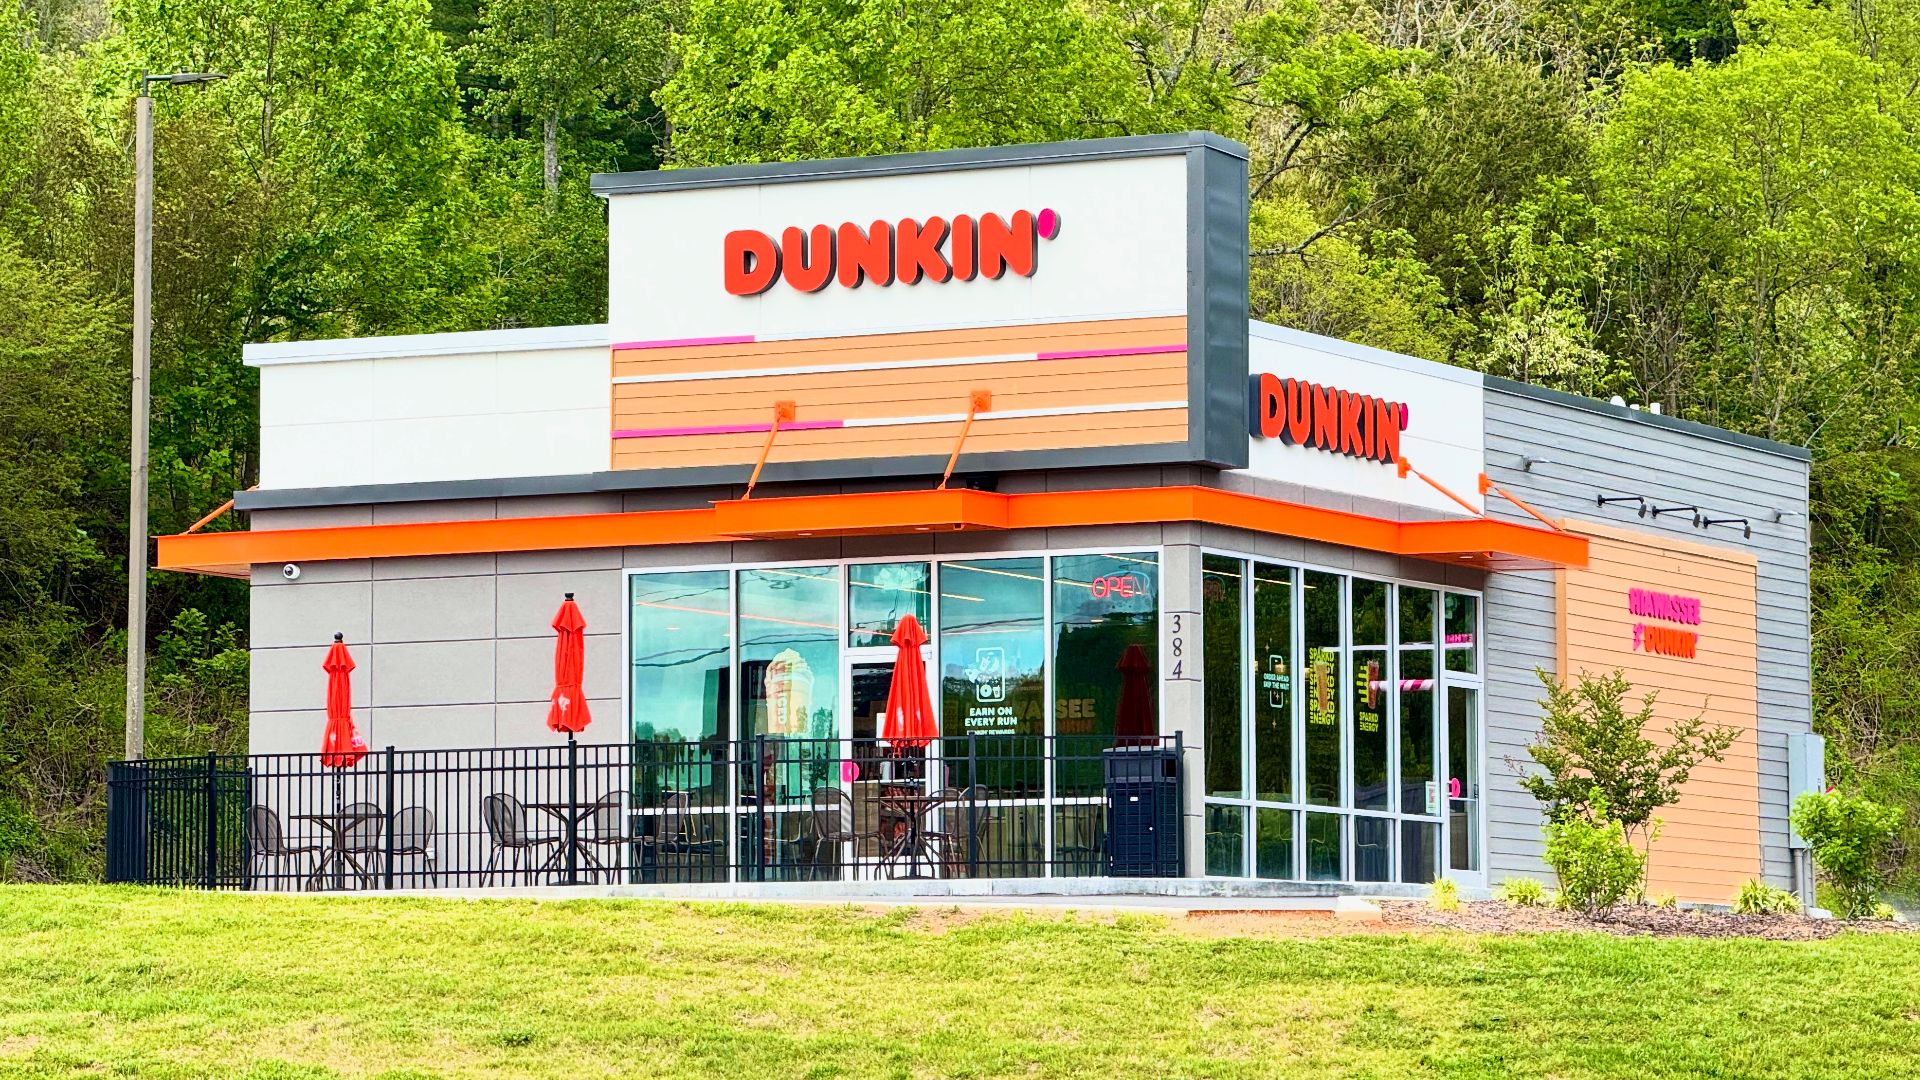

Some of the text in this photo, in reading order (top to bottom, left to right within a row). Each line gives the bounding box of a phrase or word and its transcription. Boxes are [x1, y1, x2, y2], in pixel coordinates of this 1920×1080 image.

[724, 208, 1060, 296] DUNKIN'
[1258, 373, 1409, 465] DUNKIN'
[1091, 576, 1146, 598] OPEN
[1629, 587, 1701, 626] HIAWASSEE
[1172, 614, 1183, 679] 384
[964, 716, 1018, 727] EVERY RUN
[969, 706, 1013, 717] EARN ON
[1359, 721, 1379, 733] ENERGY
